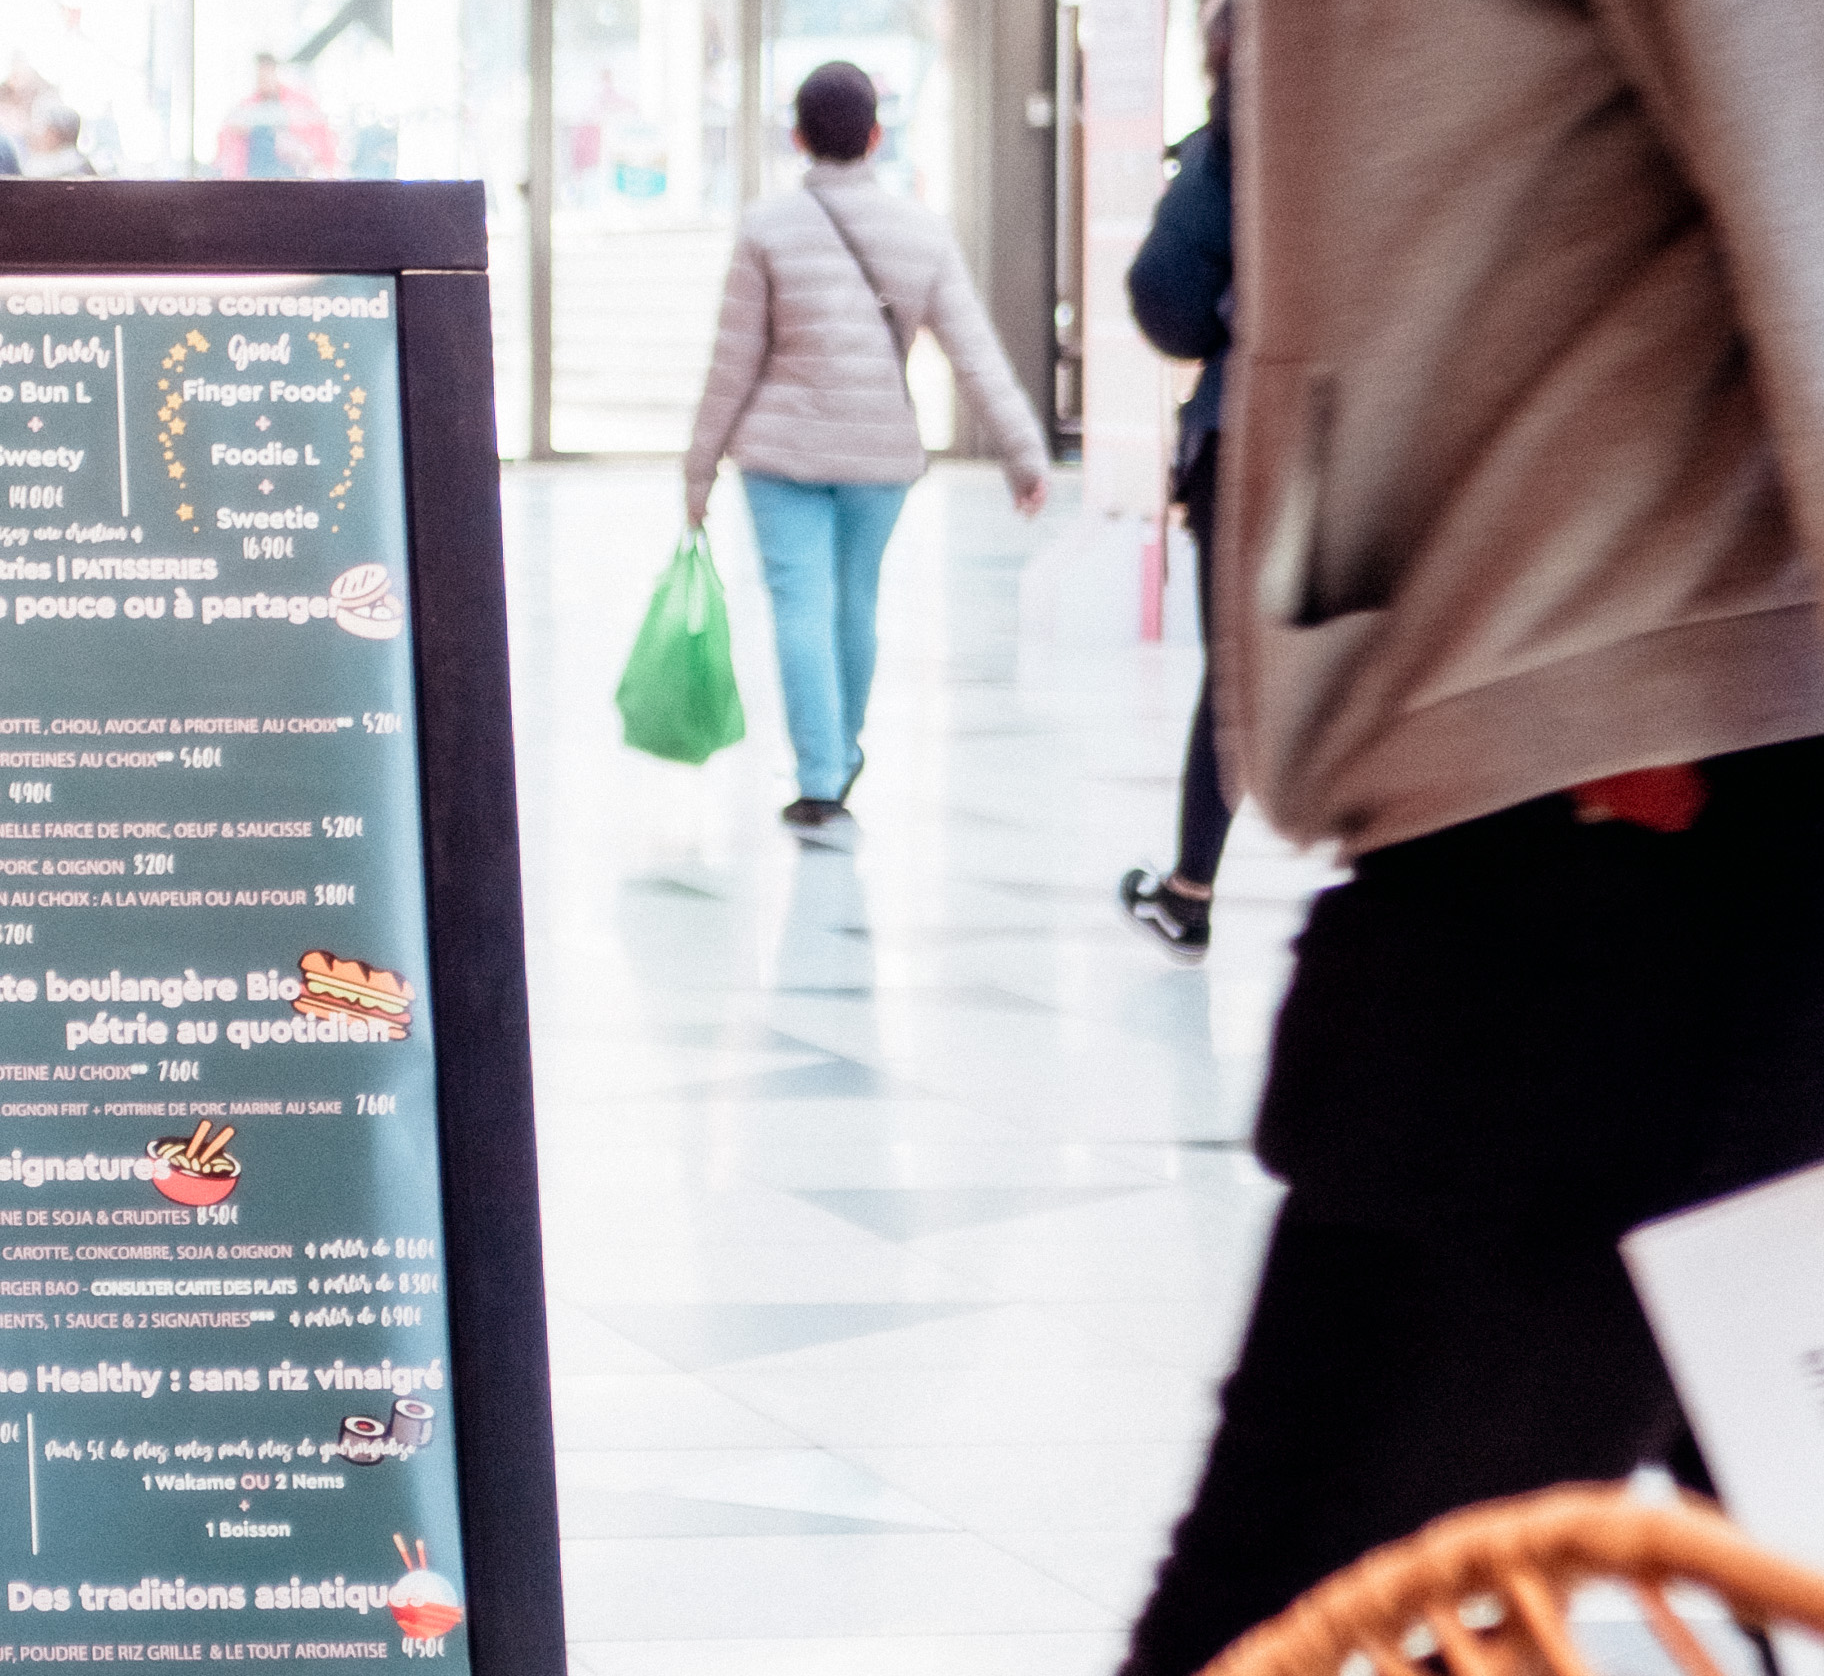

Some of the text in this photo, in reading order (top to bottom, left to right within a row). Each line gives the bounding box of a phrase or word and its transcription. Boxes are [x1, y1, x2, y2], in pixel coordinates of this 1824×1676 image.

[7, 291, 77, 315] celle
[86, 293, 135, 320] qui
[142, 296, 212, 316] vous
[218, 290, 389, 322] correspond
[21, 381, 69, 403] Bun
[76, 381, 92, 403] L
[183, 378, 264, 407] Finger
[211, 442, 320, 466] Foodie L
[217, 505, 319, 529] Sweetie
[72, 557, 218, 580] PATISSERIES
[15, 596, 117, 624] pouce
[124, 596, 166, 619] ou
[174, 587, 194, 618] à
[202, 594, 339, 623] partager
[46, 969, 238, 1008] boulangère
[247, 969, 300, 1001] Bio
[66, 1011, 390, 1050] pétrie au quotidien
[45, 1280, 79, 1296] BAO
[91, 1279, 174, 1296] CONSULTER
[177, 1279, 222, 1296] CARTE
[224, 1279, 252, 1295] DES
[254, 1278, 297, 1295] PLATS
[37, 1361, 162, 1398] Healthy
[189, 1368, 261, 1392] sans
[269, 1360, 309, 1390] riz
[314, 1359, 443, 1395] vinaigré
[143, 1472, 345, 1490] 1 Wakame OU 2 Nems
[206, 1520, 291, 1538] 1 Boisson
[8, 1581, 71, 1611] Des
[78, 1577, 247, 1611] traditions
[255, 1577, 426, 1613] asiatiques
